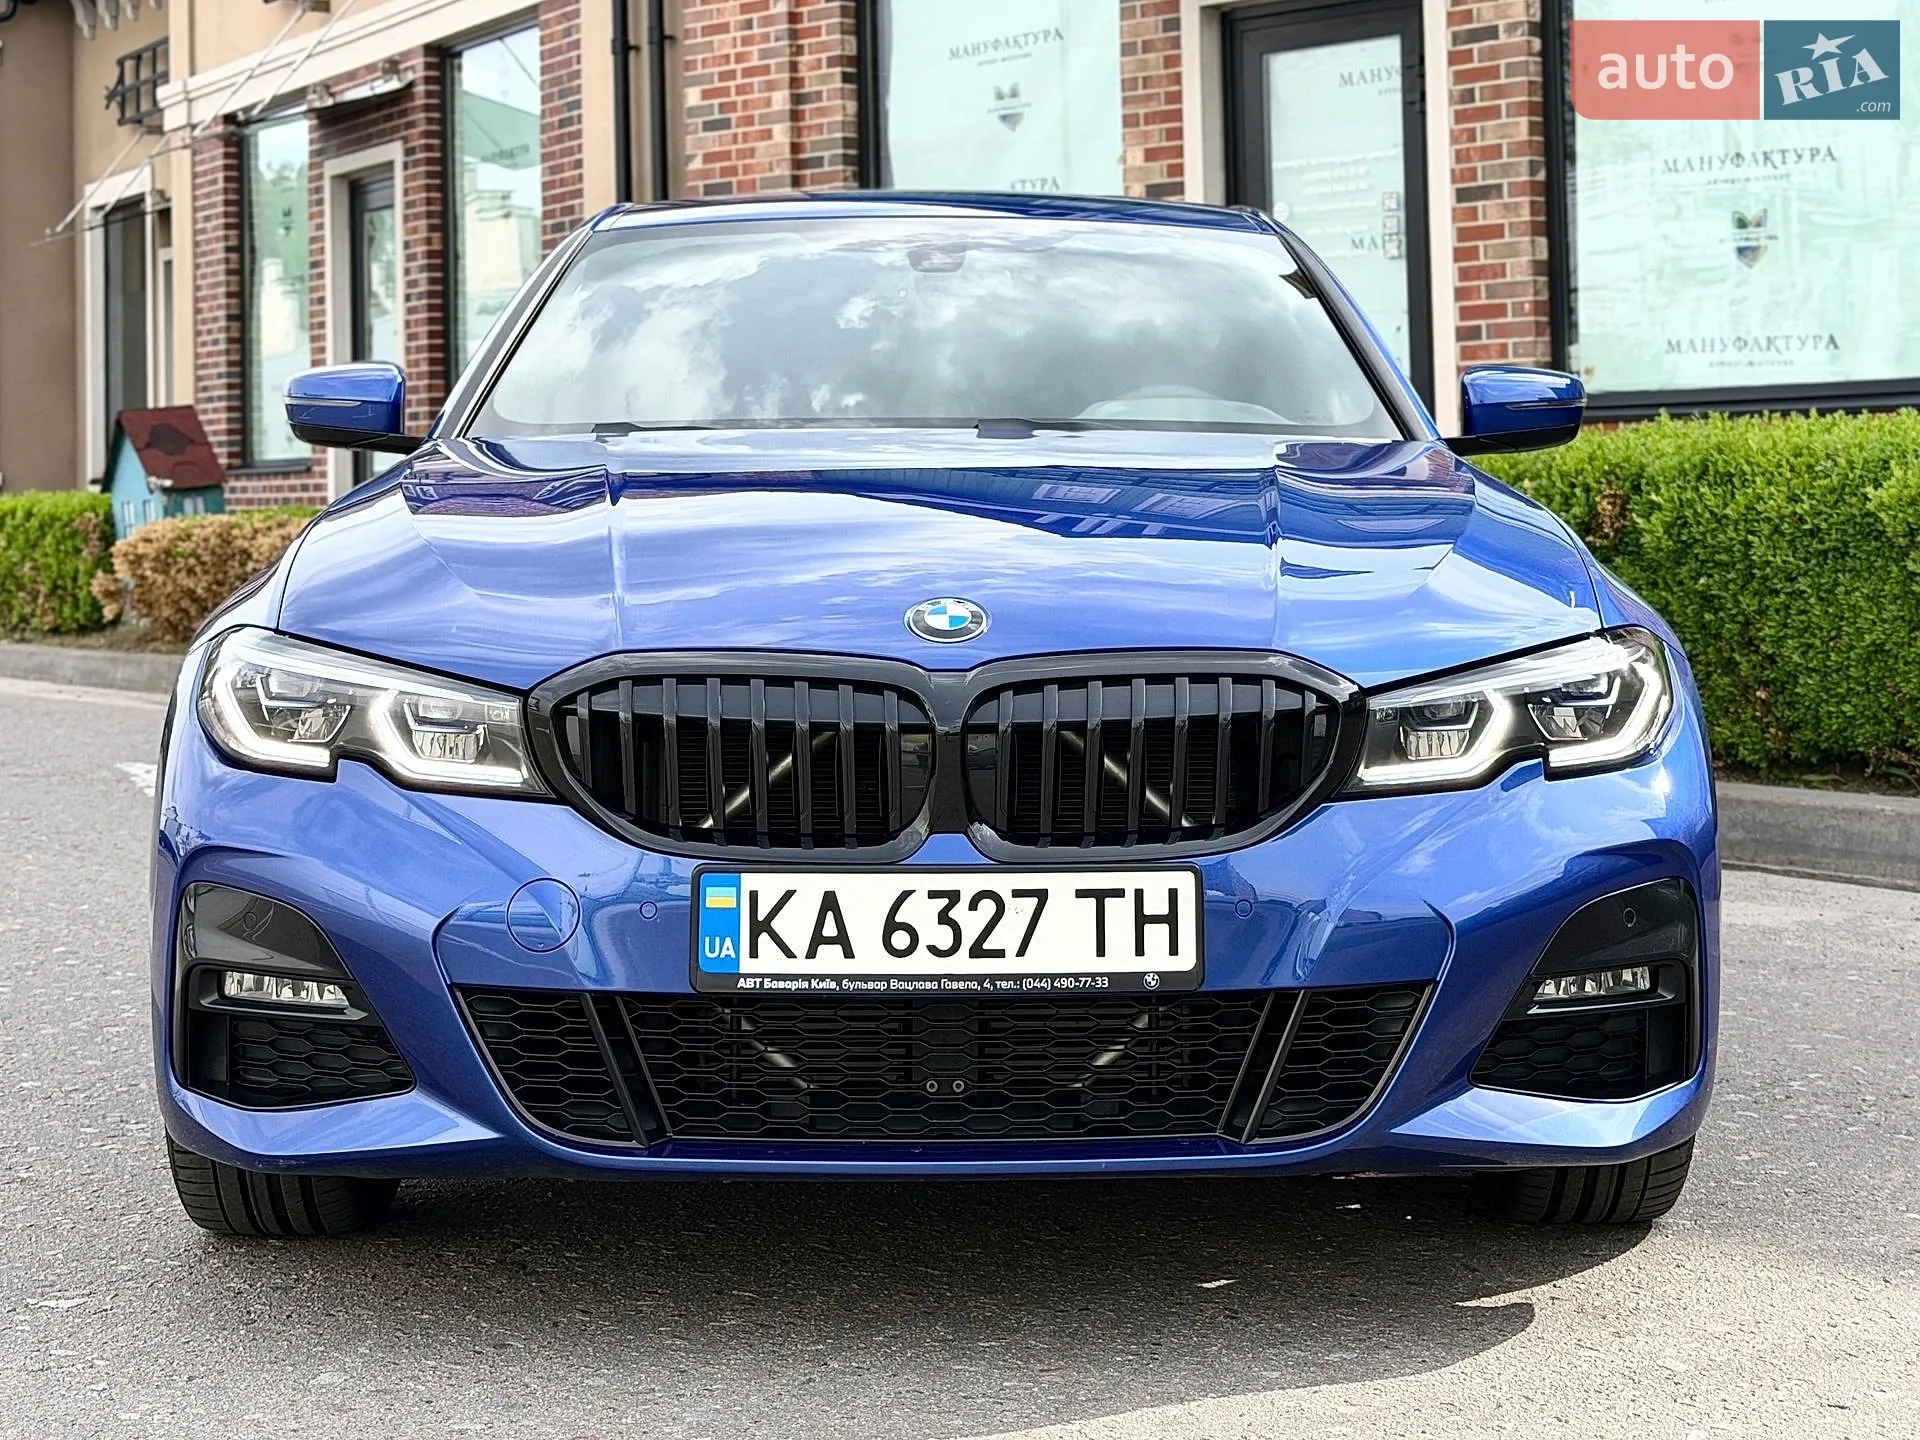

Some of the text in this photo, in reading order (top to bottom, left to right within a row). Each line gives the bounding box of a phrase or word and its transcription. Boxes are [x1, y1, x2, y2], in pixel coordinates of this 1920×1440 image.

[948, 27, 1064, 60] МАНУФАКТУРА
[1661, 144, 1838, 174] МАНУФАКТУРА
[1664, 333, 1841, 356] МАНУФАКТУРА
[749, 887, 1179, 960] KA 6327 TH
[703, 936, 737, 959] UA
[737, 977, 763, 990] АВТ
[763, 977, 809, 991] Баварія
[810, 977, 840, 991] Київ,
[841, 978, 888, 992] бульвар
[889, 978, 939, 992] Вацлава
[982, 978, 994, 991] 4,
[995, 979, 1021, 990] тел.:
[1022, 977, 1052, 991] (044)
[1053, 976, 1109, 989] 490-77-33
